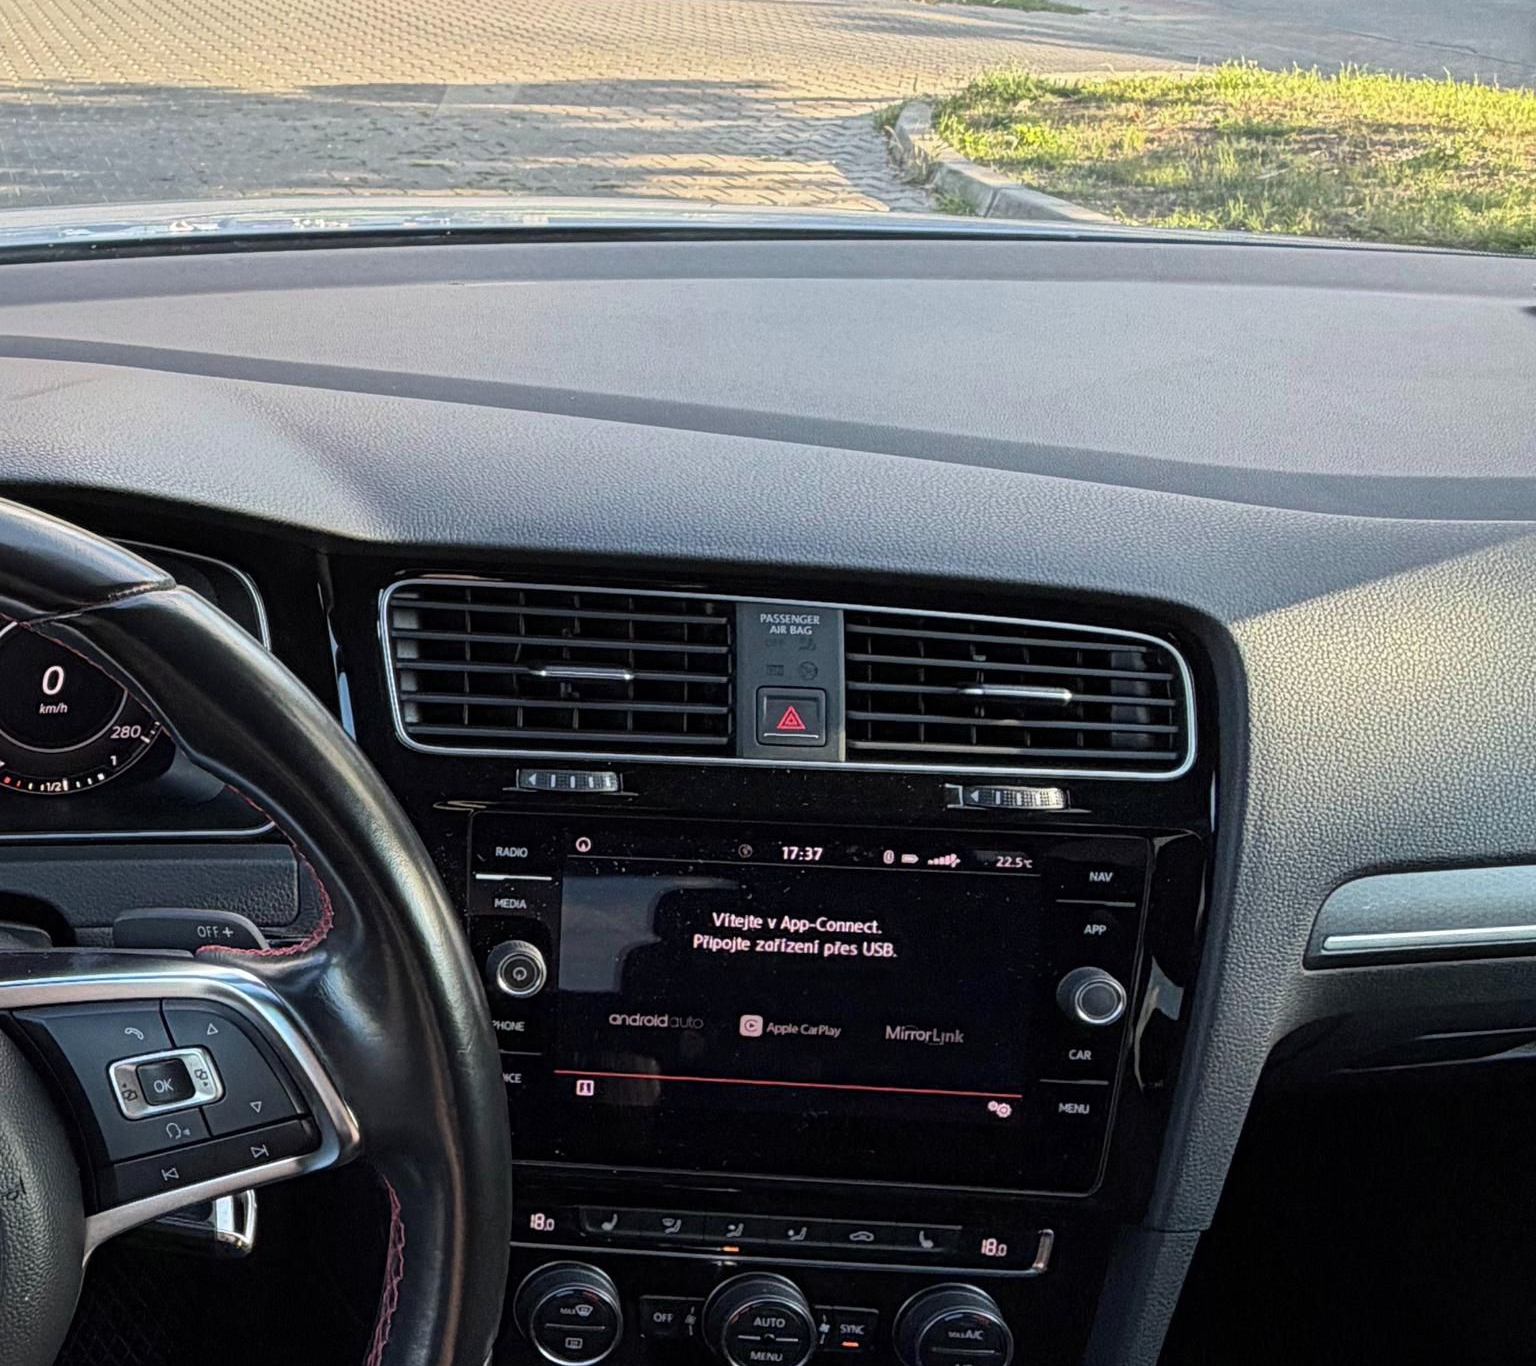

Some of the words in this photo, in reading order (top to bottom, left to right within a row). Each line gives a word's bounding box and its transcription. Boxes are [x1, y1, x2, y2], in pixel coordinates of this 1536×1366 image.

[760, 614, 820, 625] PASSENGER
[769, 625, 787, 635] AIR
[790, 626, 813, 636] BAG
[42, 665, 65, 696] 0
[39, 703, 68, 715] km/h
[110, 725, 142, 739] 280
[110, 755, 117, 766] 1
[495, 846, 528, 858] RADIO
[782, 846, 824, 861] 17:37
[1089, 871, 1113, 883] NAV
[494, 898, 527, 910] MEDIA
[712, 911, 763, 931] Vítejte
[767, 916, 777, 929] v
[780, 915, 883, 935] App-Connect.
[1084, 924, 1107, 936] APP
[693, 933, 751, 953] Připojte
[755, 936, 819, 955] zařízení
[824, 939, 858, 958] přes
[863, 941, 898, 959] USB.
[766, 1022, 798, 1037] Apple
[800, 1024, 842, 1039] CarPlay
[885, 1024, 964, 1046] MirrorLink
[1069, 1049, 1092, 1061] CAR
[153, 1077, 175, 1093] OK
[1058, 1102, 1090, 1115] MENU
[530, 1213, 555, 1231] 18.0
[981, 1238, 1008, 1257] 18.0
[653, 1312, 673, 1323] OFF
[753, 1317, 786, 1328] AUTO
[840, 1324, 865, 1335] SYNC
[750, 1350, 783, 1362] MENU
